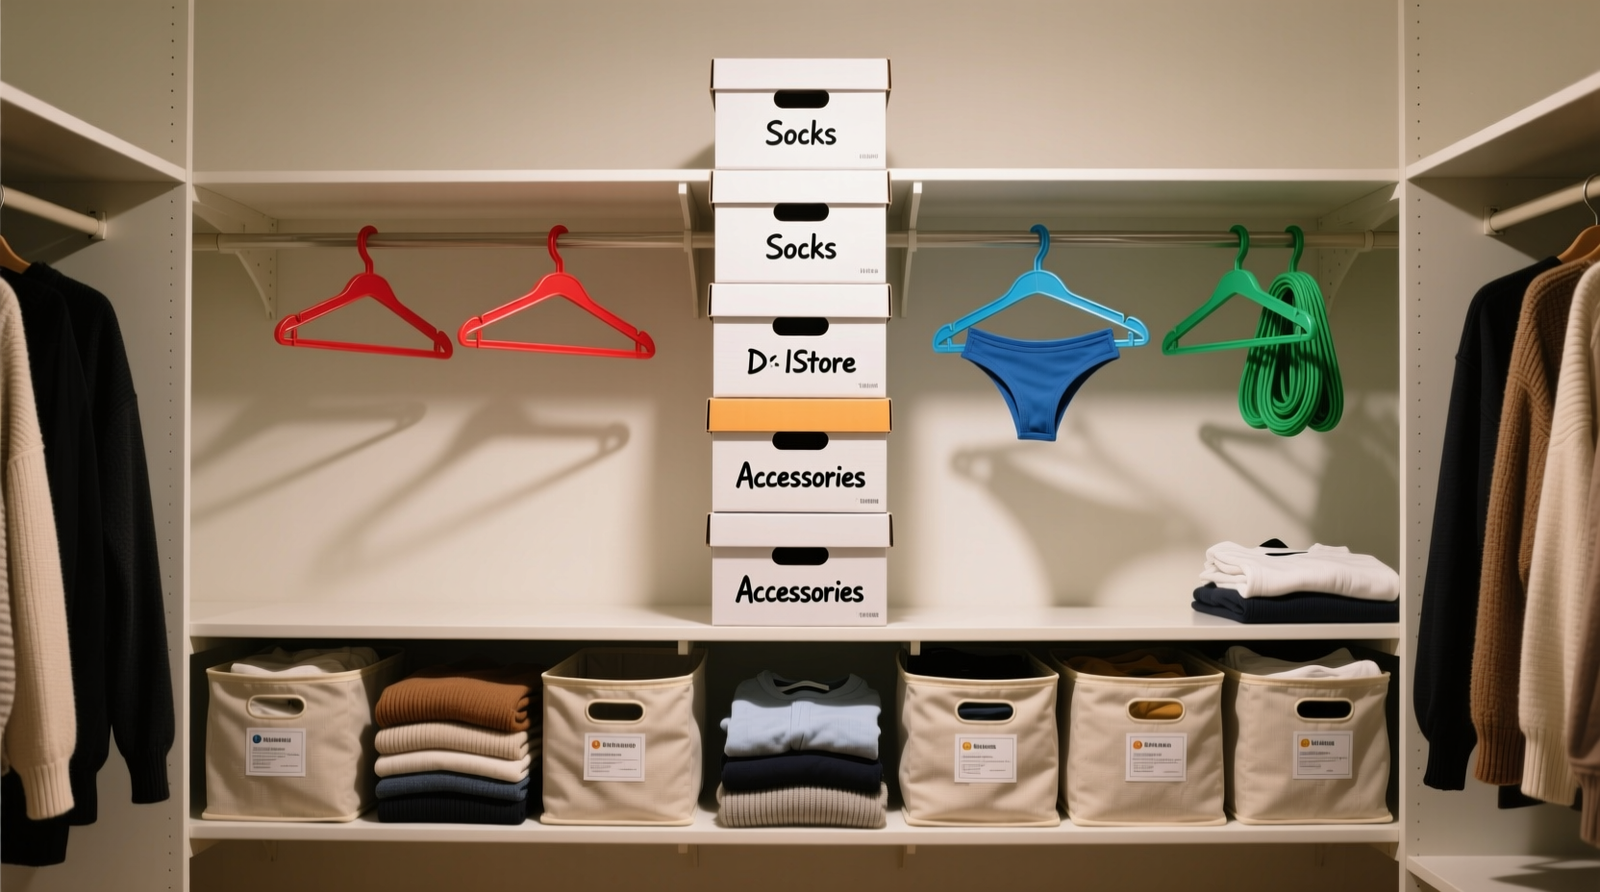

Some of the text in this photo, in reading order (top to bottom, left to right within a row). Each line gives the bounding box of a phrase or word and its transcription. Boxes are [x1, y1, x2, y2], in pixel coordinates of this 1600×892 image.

[765, 119, 837, 146] Socks
[765, 232, 837, 260] Socks
[736, 461, 866, 490] Accessories
[735, 574, 864, 603] Accessories
